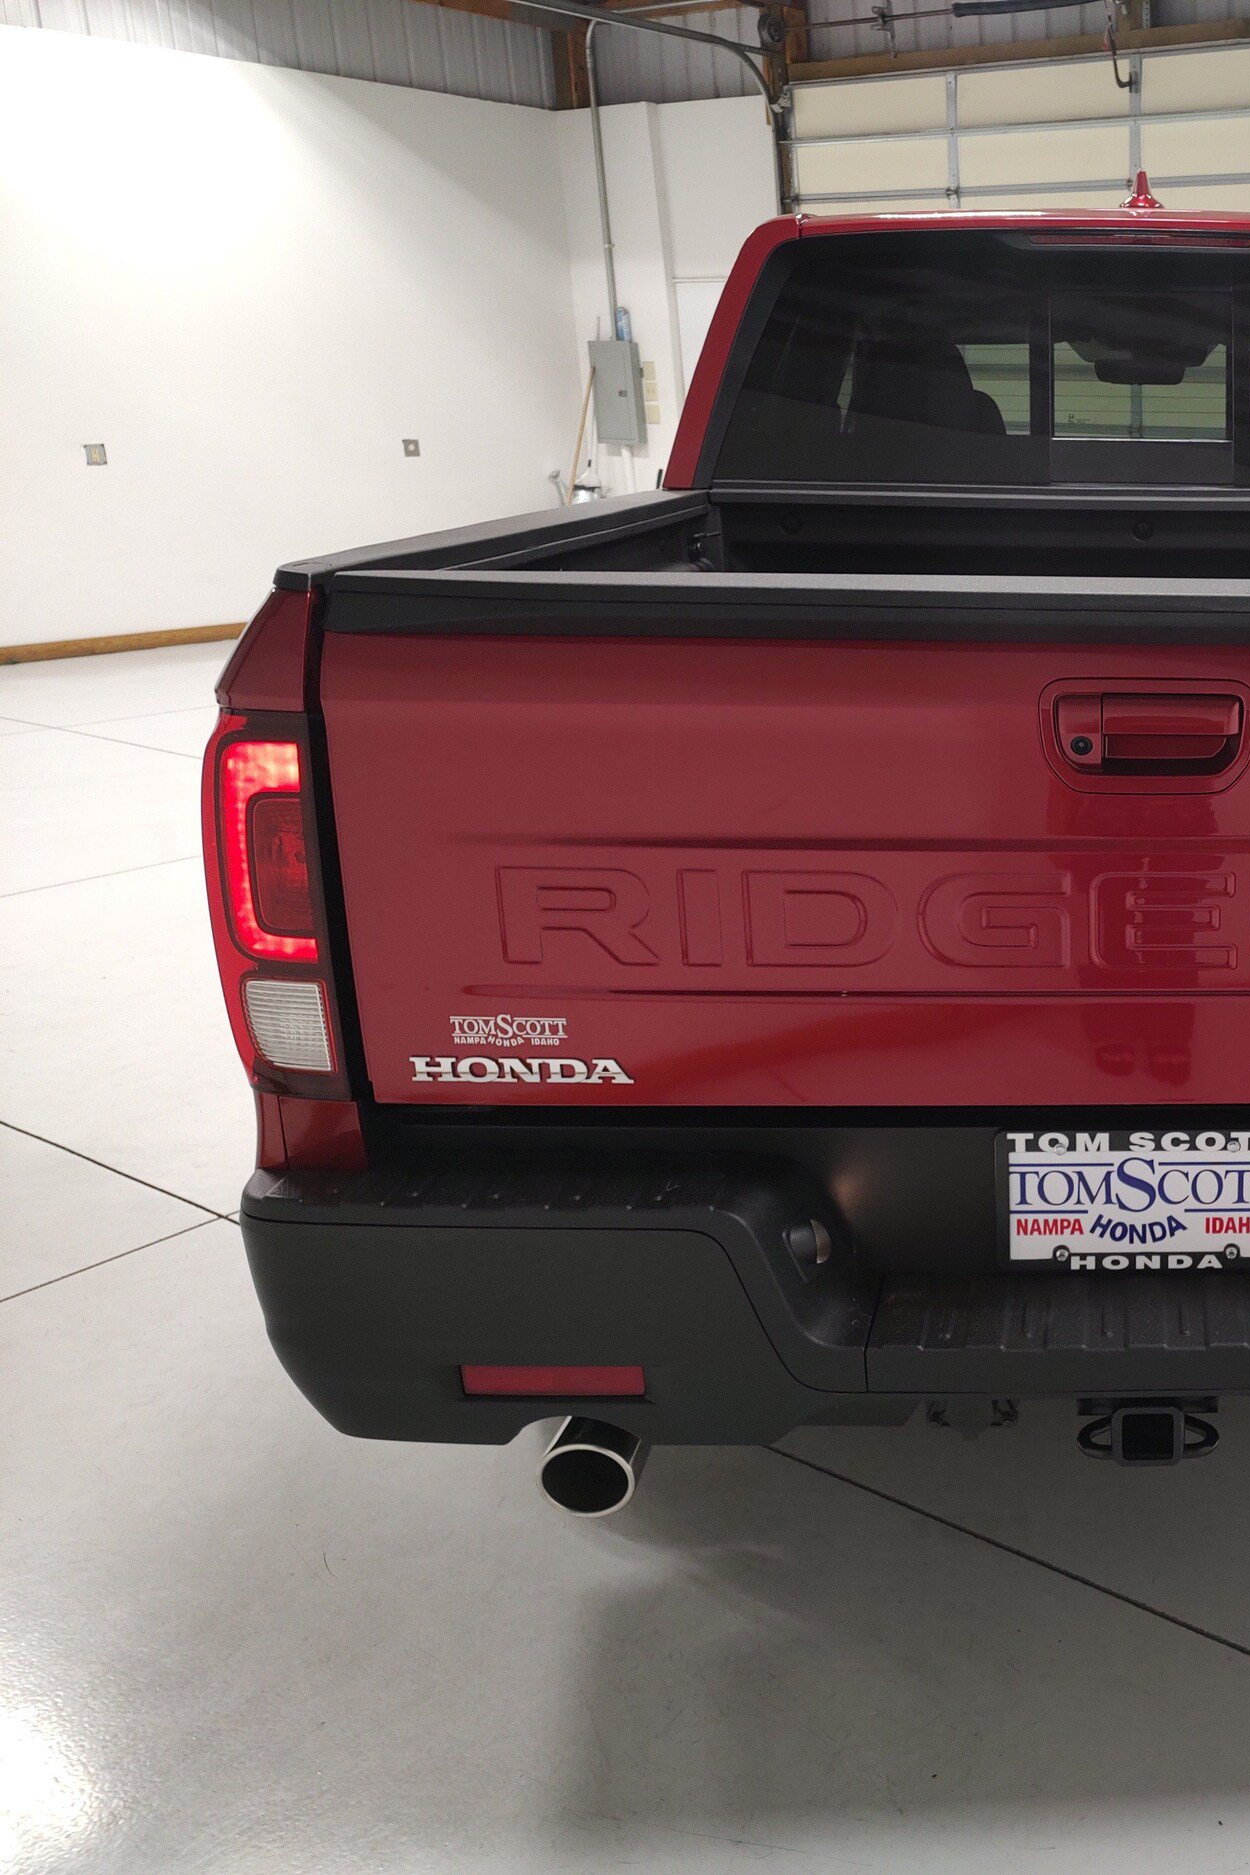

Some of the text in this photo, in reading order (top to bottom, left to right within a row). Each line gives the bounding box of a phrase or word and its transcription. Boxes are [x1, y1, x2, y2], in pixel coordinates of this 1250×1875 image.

[454, 1035, 560, 1047] NAMPA HONDA IDAHO
[409, 1056, 635, 1084] HONDA
[1007, 1132, 1110, 1153] TOM
[1016, 1218, 1084, 1235] NAMPA
[1089, 1214, 1188, 1244] HONDA
[1070, 1254, 1223, 1270] HONDA
